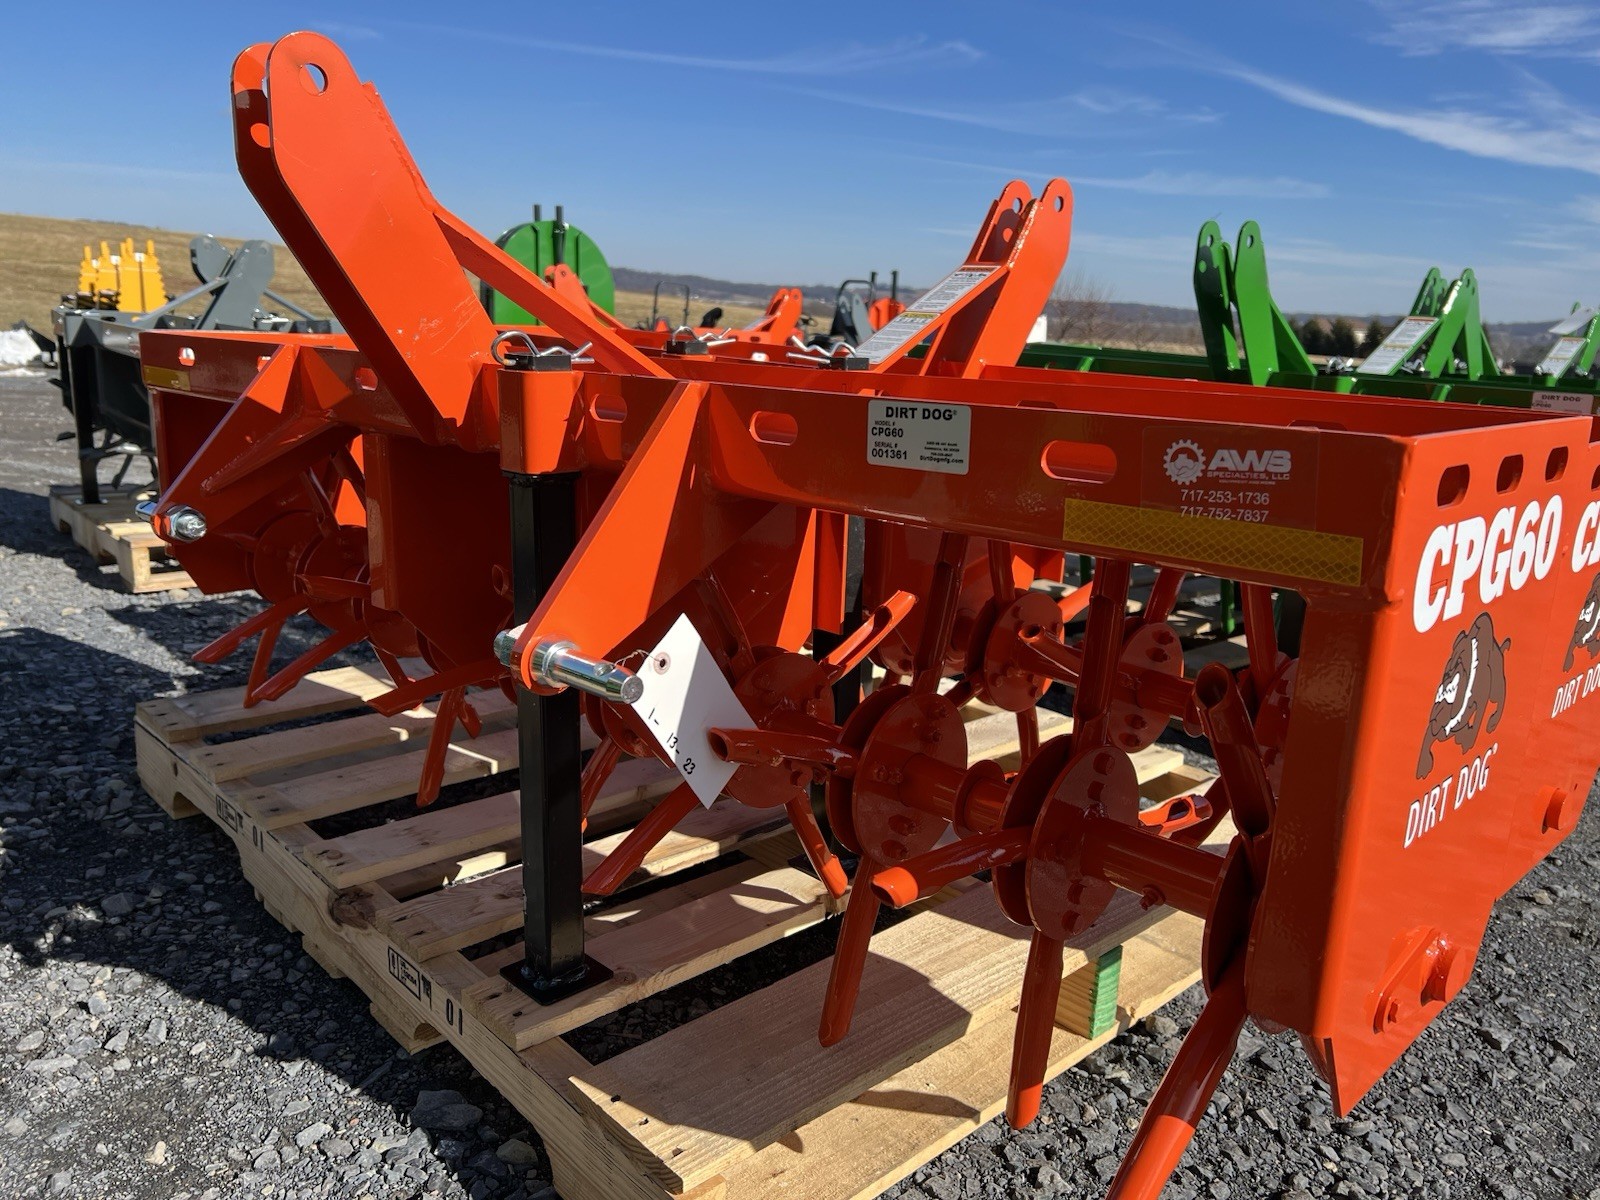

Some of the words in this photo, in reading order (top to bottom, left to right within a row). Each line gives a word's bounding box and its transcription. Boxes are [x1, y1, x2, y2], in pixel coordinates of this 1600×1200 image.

[885, 406, 918, 419] DIRT
[871, 426, 904, 438] CPG60
[874, 441, 893, 449] SERIAL
[871, 448, 908, 460] 001361
[1208, 450, 1292, 473] AWS
[1206, 470, 1270, 480] SPECIALTIES,
[1271, 472, 1290, 481] LLC
[1181, 490, 1270, 505] 717-253-1736
[1181, 506, 1270, 522] 717-752-7837
[1412, 494, 1563, 634] CPG60
[1550, 673, 1584, 719] DIRT
[1403, 775, 1453, 849] DIRT
